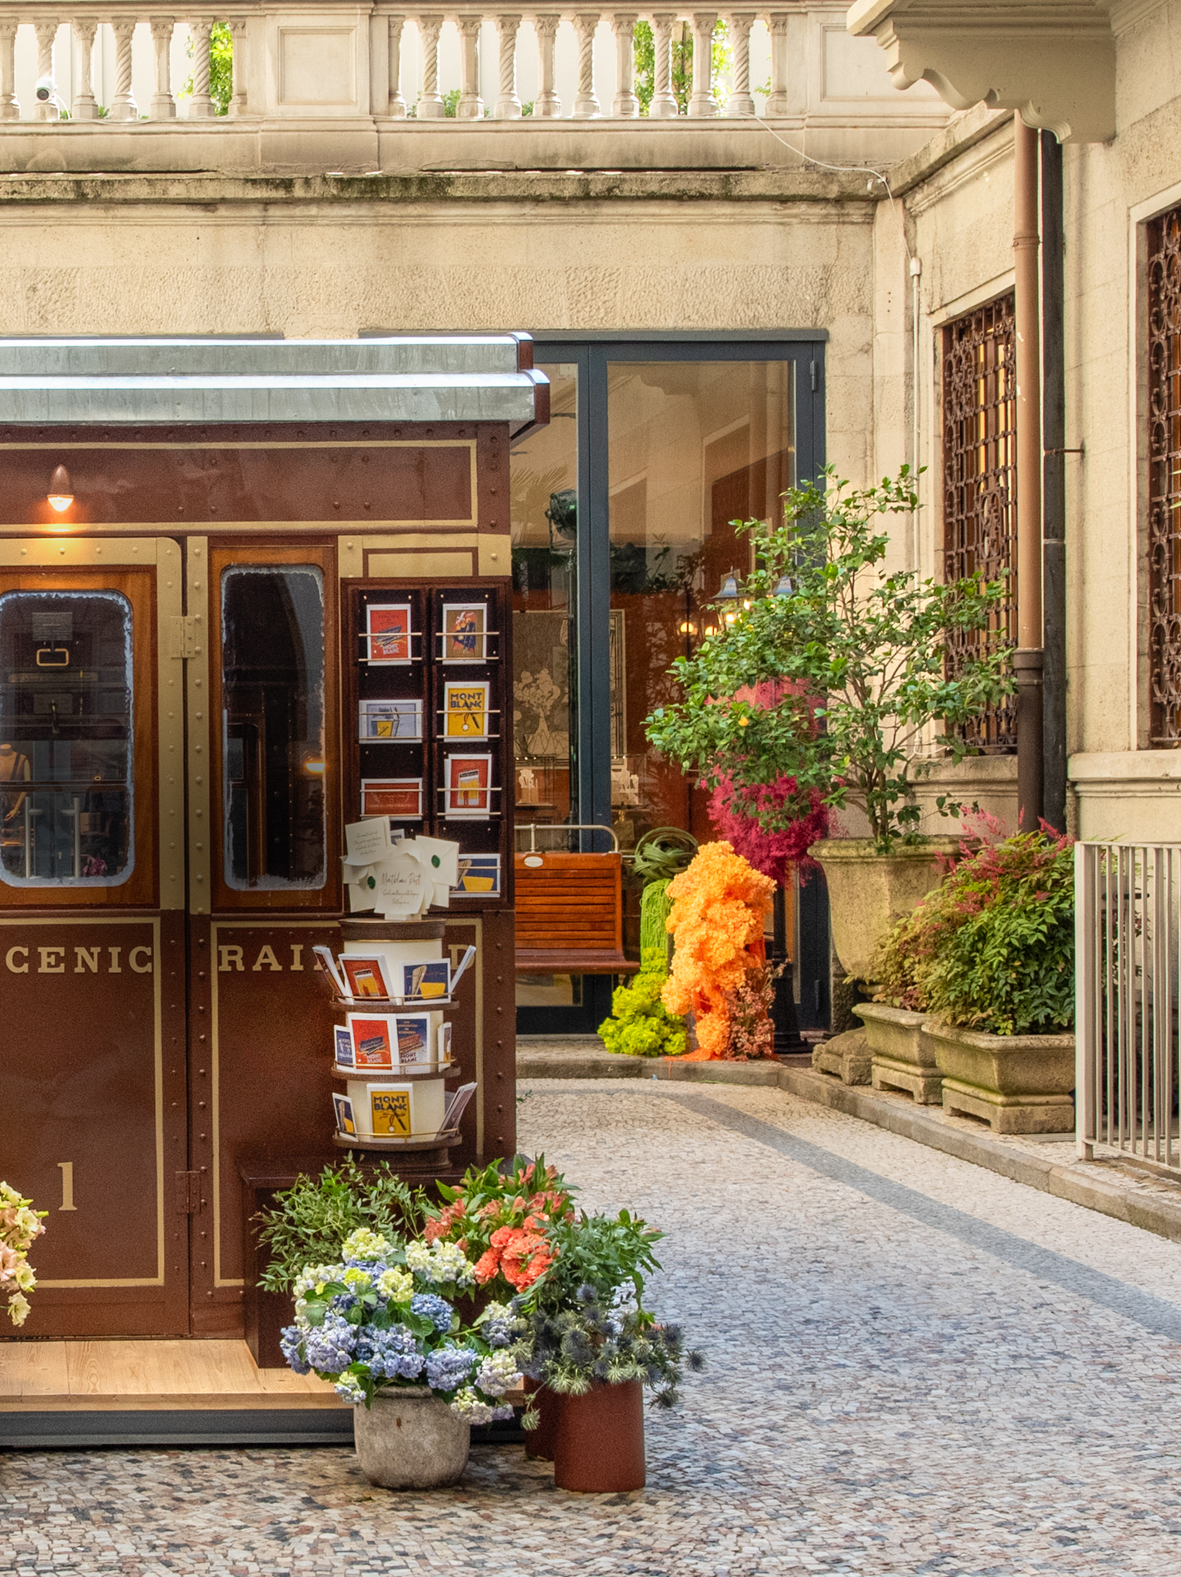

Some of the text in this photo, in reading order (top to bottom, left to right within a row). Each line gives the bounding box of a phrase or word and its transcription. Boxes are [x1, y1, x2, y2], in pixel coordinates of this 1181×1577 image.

[450, 692, 482, 700] MONT
[450, 700, 482, 709] BLANC
[373, 1095, 407, 1103] MONT
[57, 1161, 77, 1211] 1
